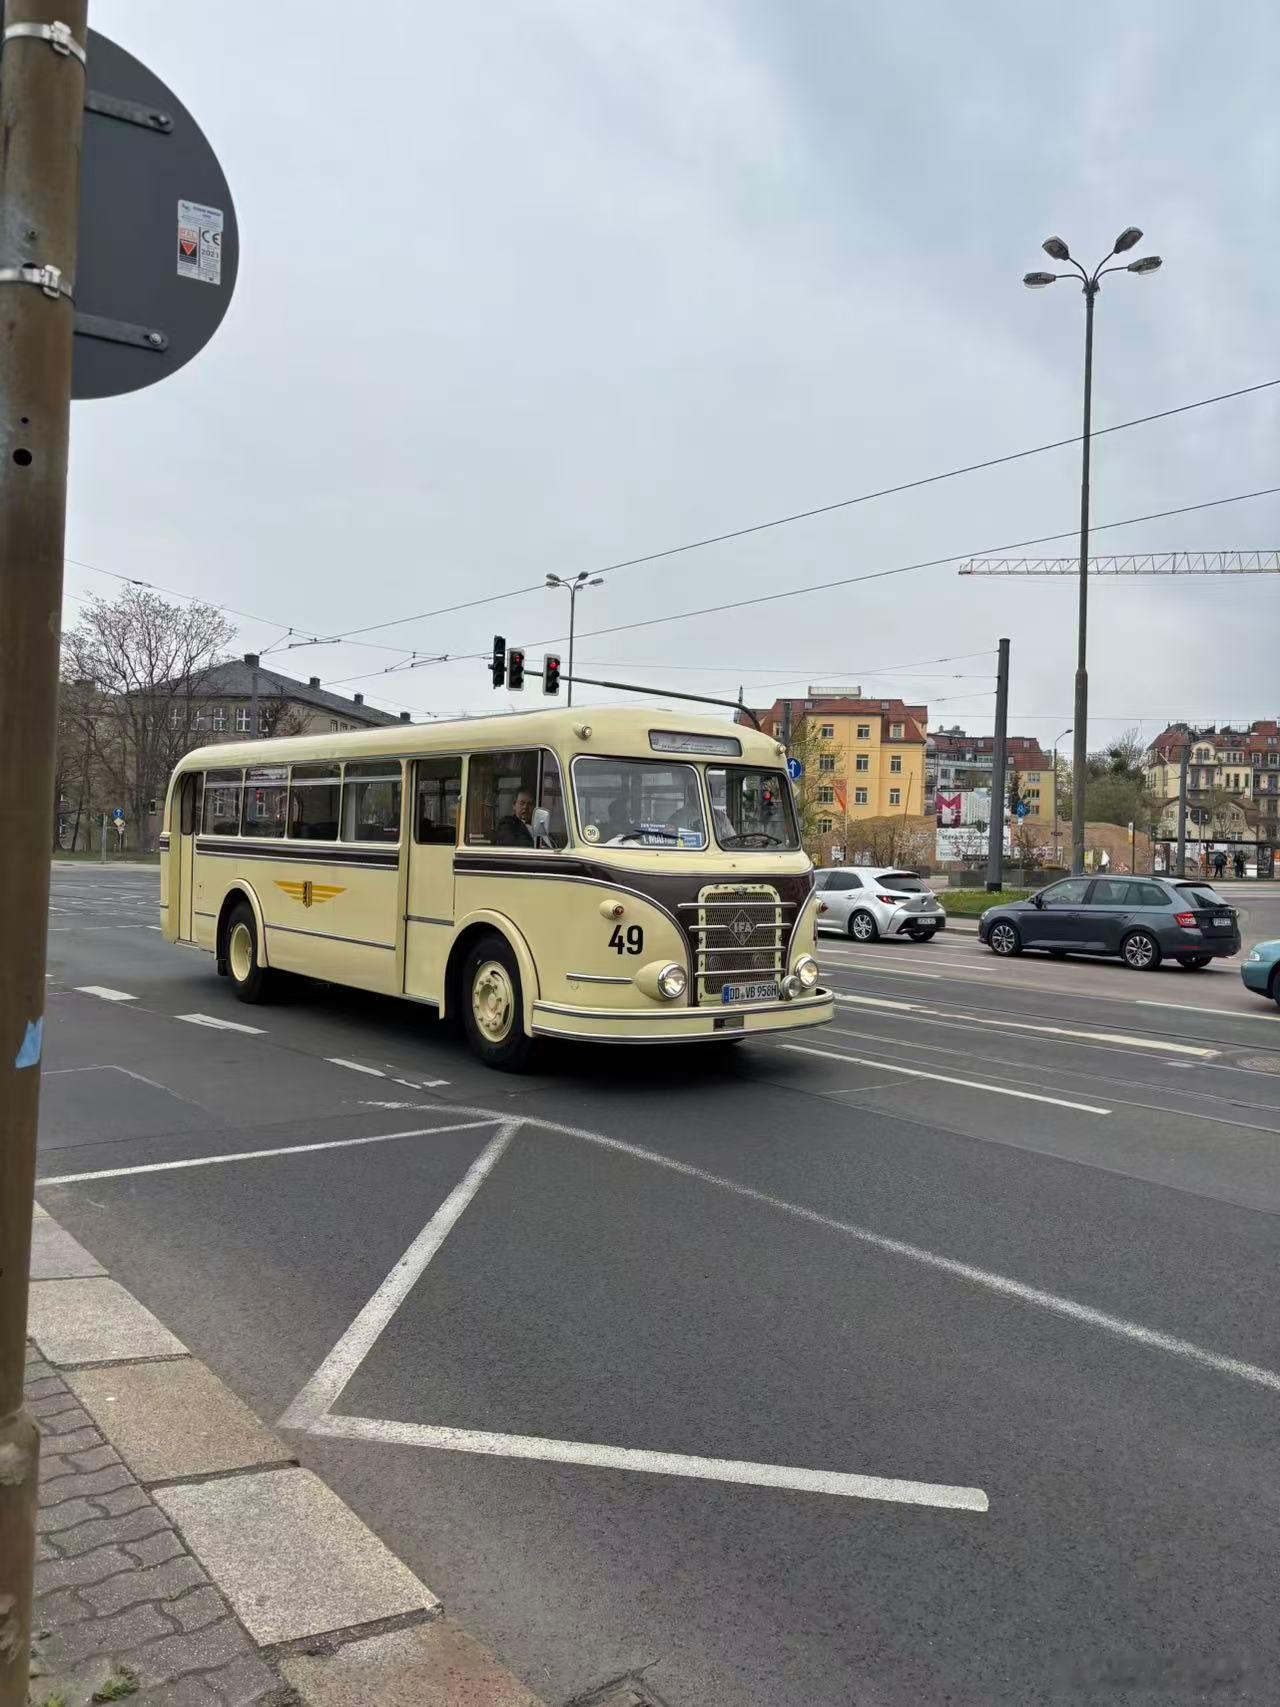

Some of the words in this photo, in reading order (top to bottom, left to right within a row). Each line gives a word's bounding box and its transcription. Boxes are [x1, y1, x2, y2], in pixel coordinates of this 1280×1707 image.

[201, 248, 219, 259] 2021
[608, 924, 643, 955] 49
[730, 988, 740, 999] DD
[745, 986, 756, 998] VB
[757, 984, 777, 997] 958H
